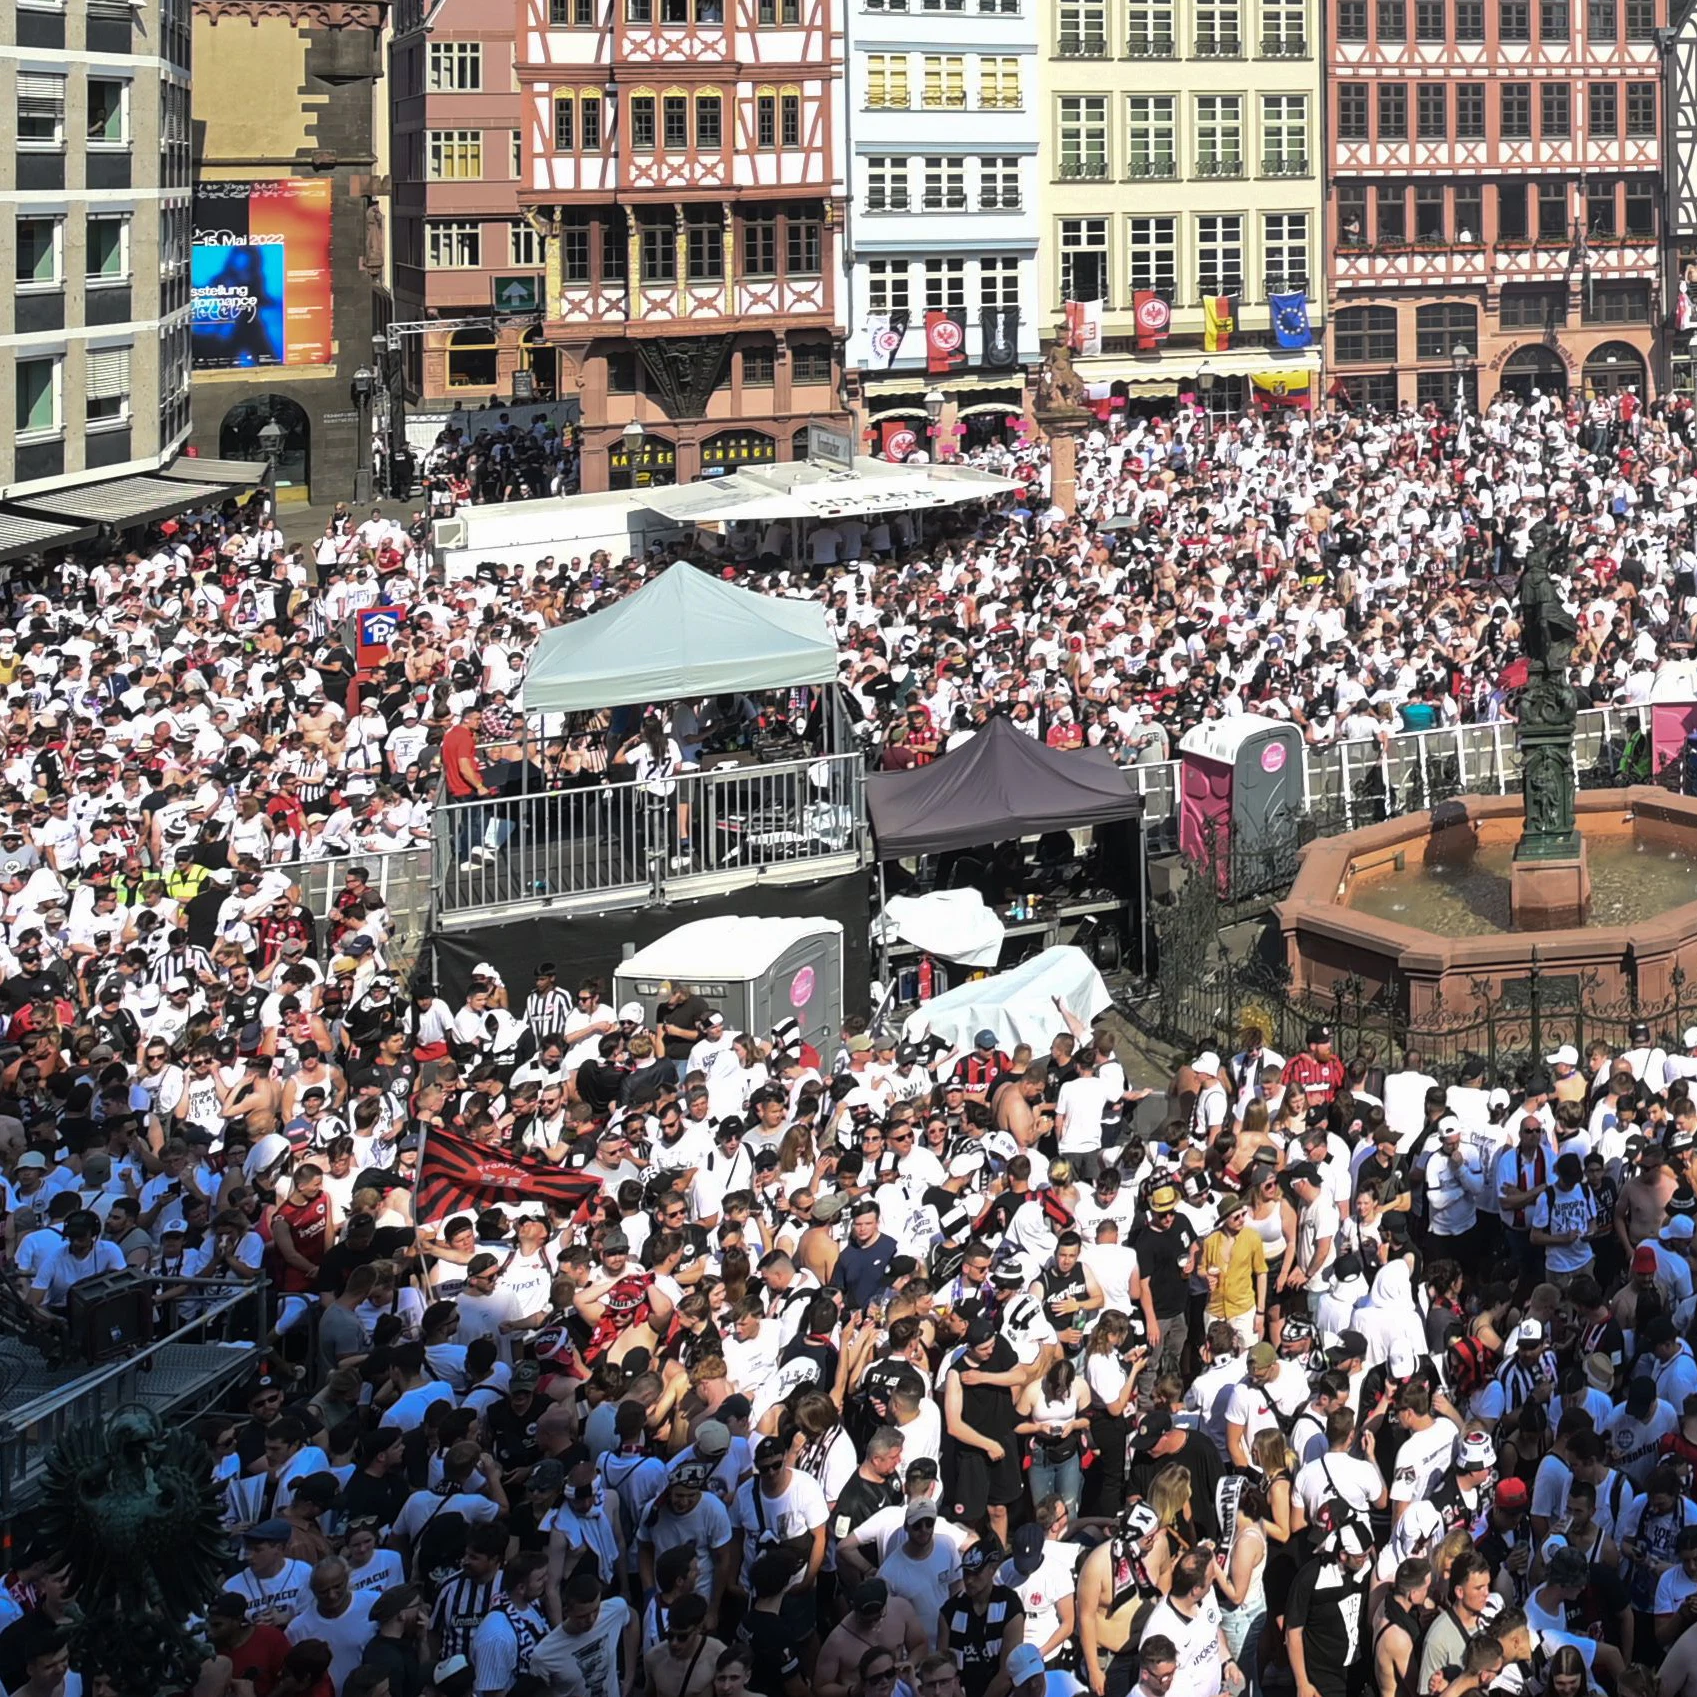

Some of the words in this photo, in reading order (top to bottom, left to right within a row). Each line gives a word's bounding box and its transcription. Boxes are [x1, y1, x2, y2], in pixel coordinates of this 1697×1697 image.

[222, 236, 248, 247] Mai
[250, 234, 285, 245] 2022
[191, 285, 249, 298] sstellung
[192, 295, 258, 307] formance
[1488, 340, 1518, 372] Römer
[1551, 337, 1579, 370] embel
[704, 445, 775, 461] CHANGE
[372, 622, 389, 643] P
